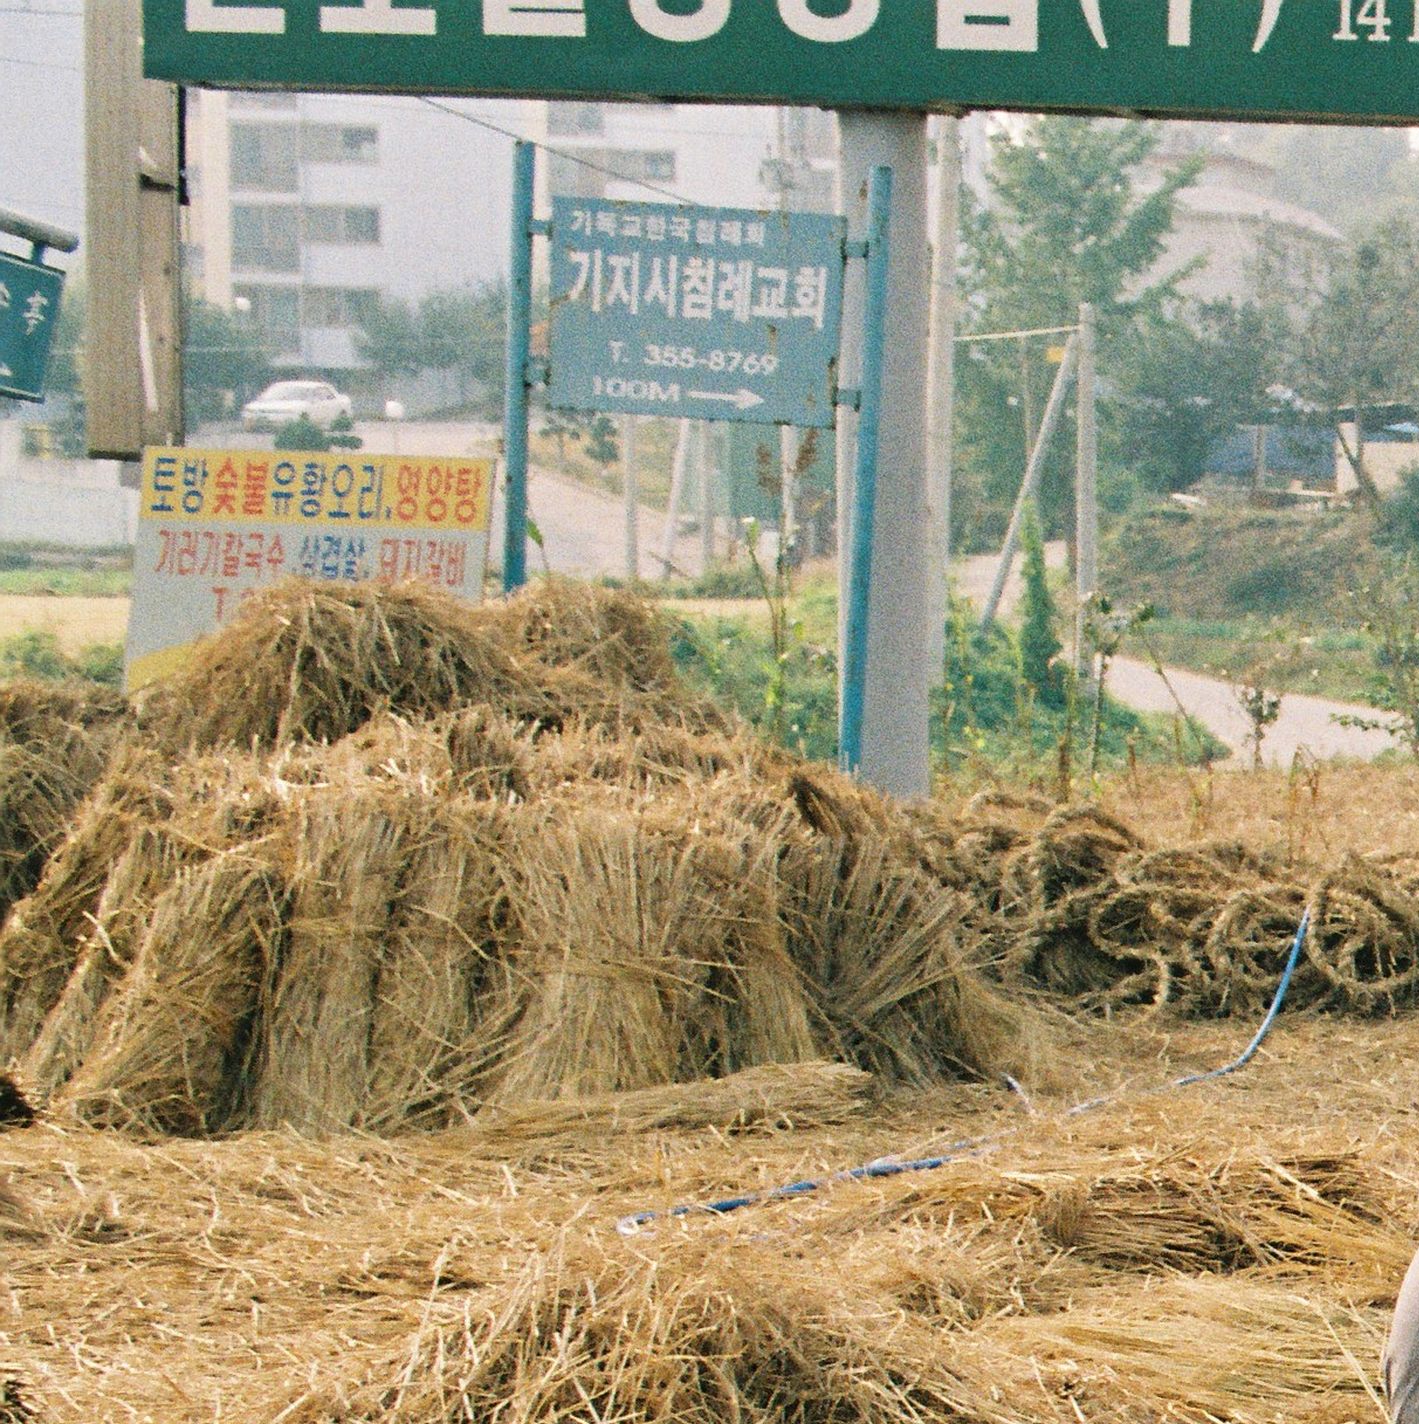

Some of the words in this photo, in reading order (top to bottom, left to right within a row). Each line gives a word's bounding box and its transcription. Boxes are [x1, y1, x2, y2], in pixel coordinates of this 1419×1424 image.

[1333, 0, 1391, 41] 14
[567, 249, 828, 329] 기지시침례교회
[644, 343, 780, 375] 355-8769
[592, 374, 681, 402] 100M
